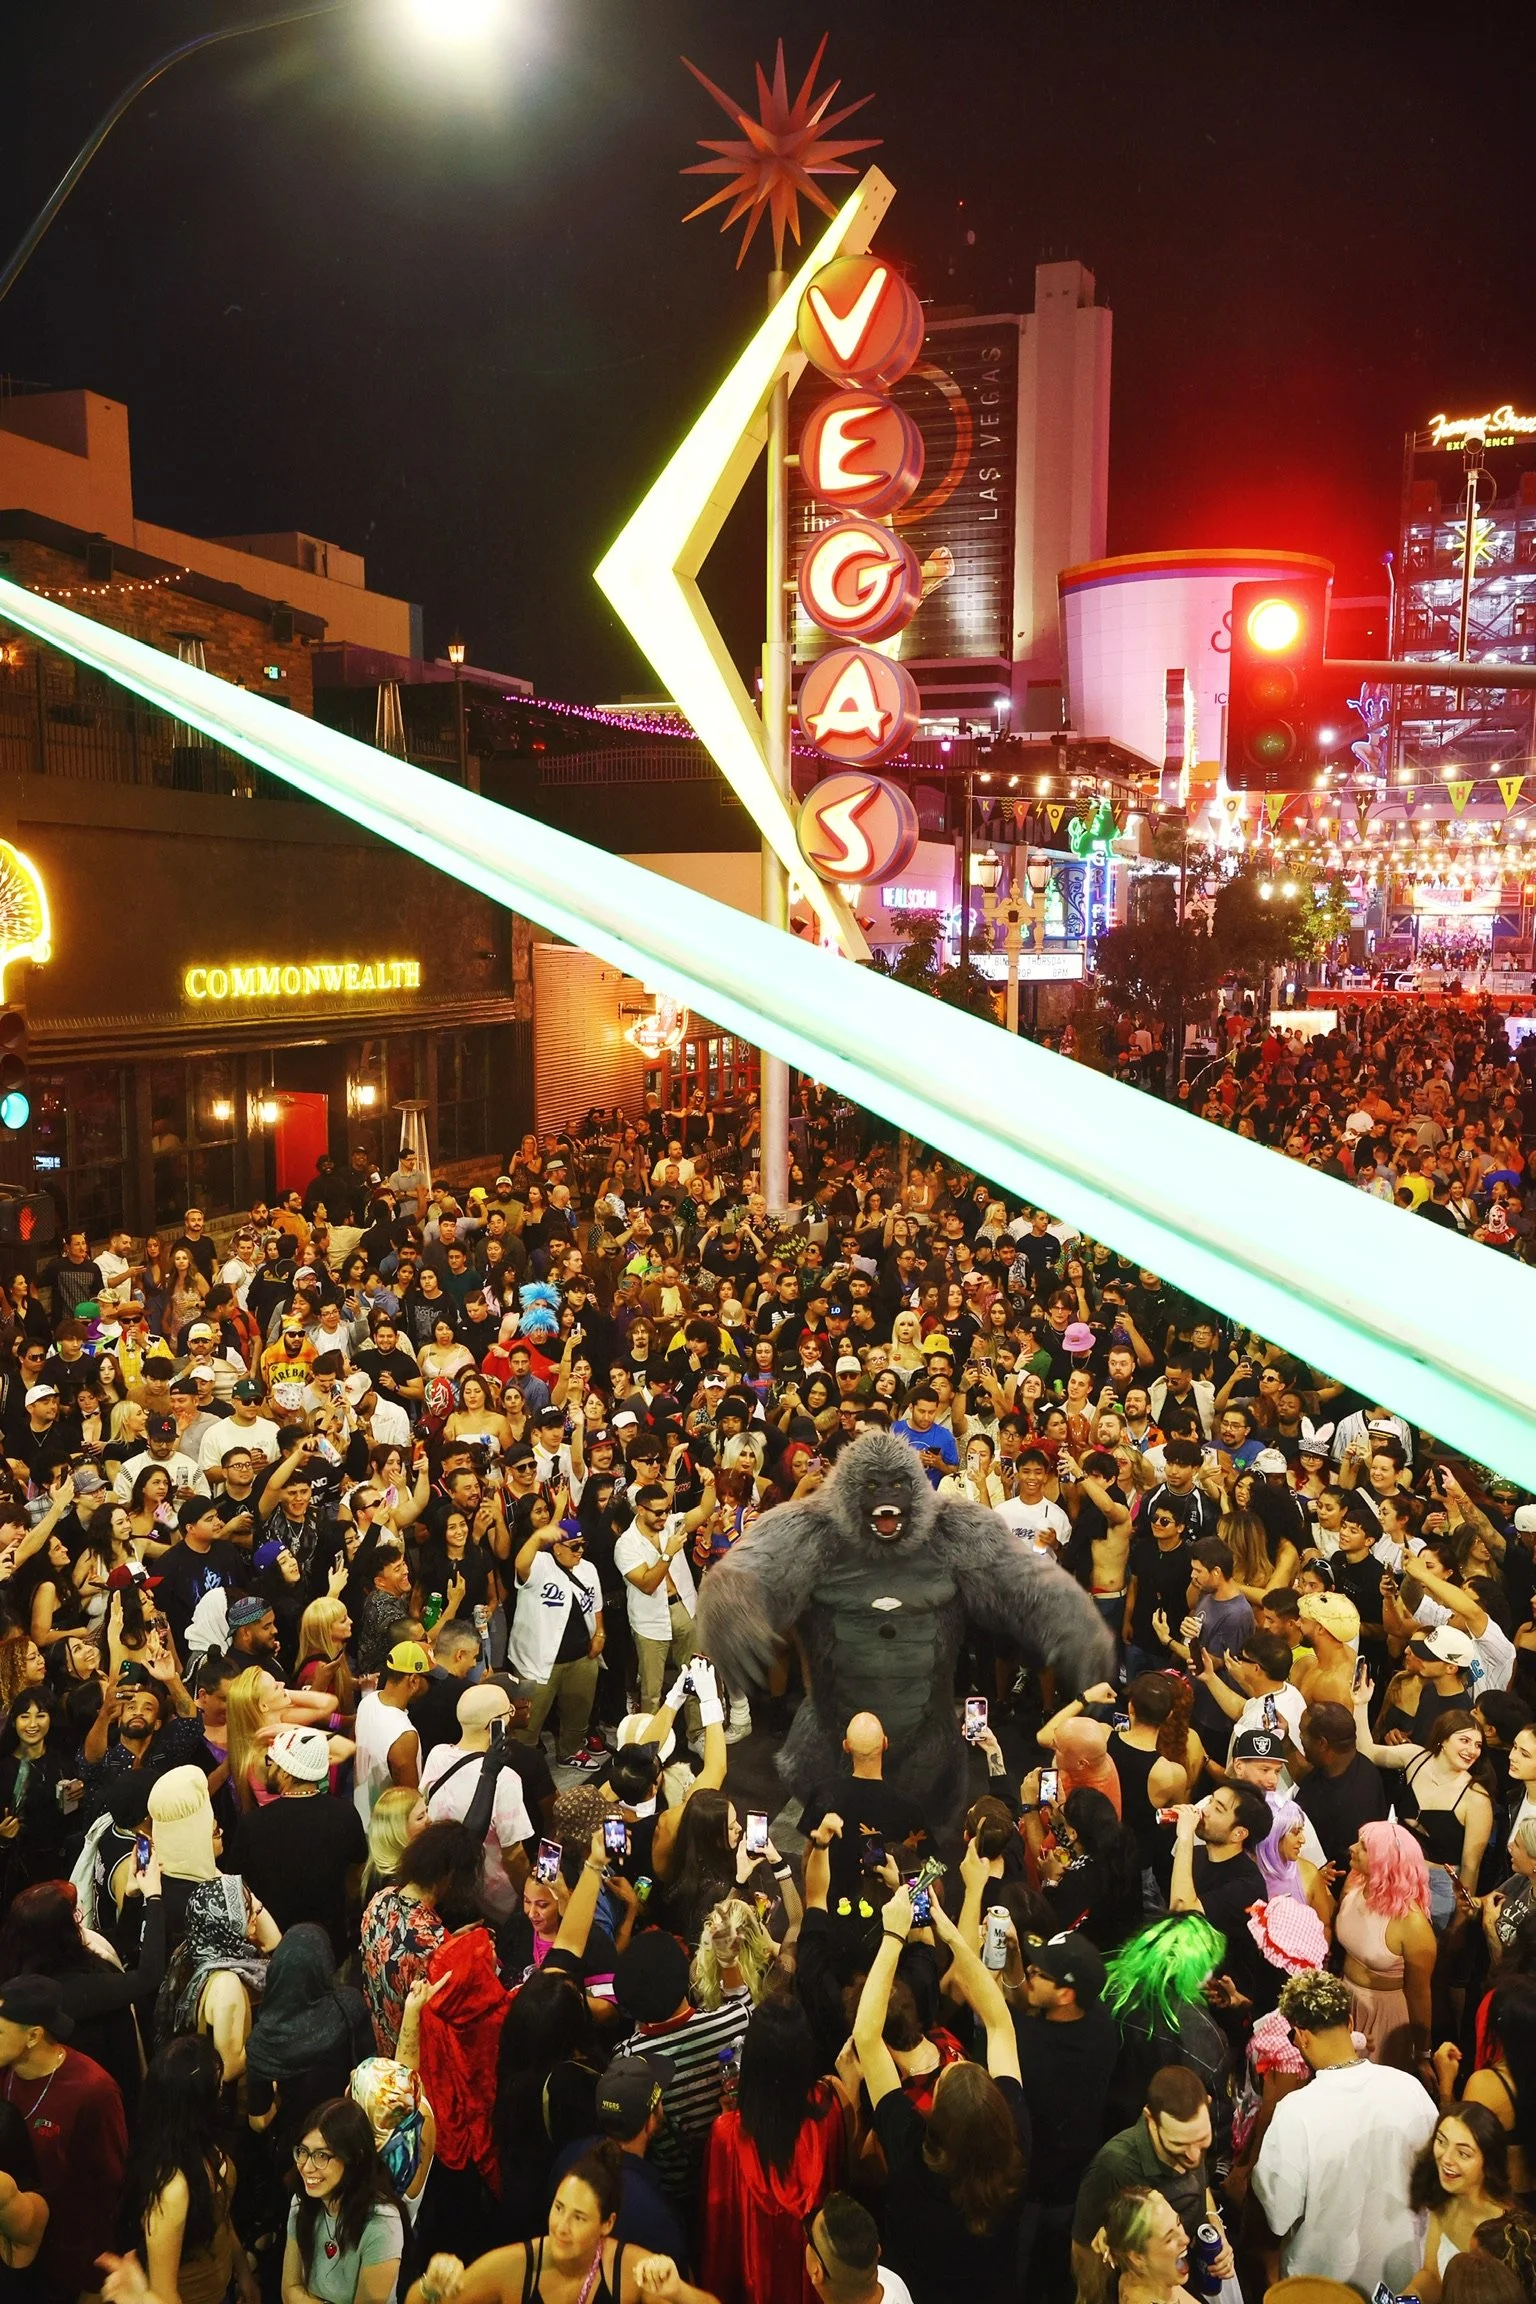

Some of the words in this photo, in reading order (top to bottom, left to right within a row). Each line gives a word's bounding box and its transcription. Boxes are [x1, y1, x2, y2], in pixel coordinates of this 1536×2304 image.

[979, 347, 1001, 447] VEGAS
[1446, 437, 1515, 451] EXPENCE
[978, 467, 1001, 521] LAS
[806, 265, 905, 878] VEGAS
[1090, 850, 1106, 971] GRIFF
[184, 961, 421, 999] COMMONWEALTH
